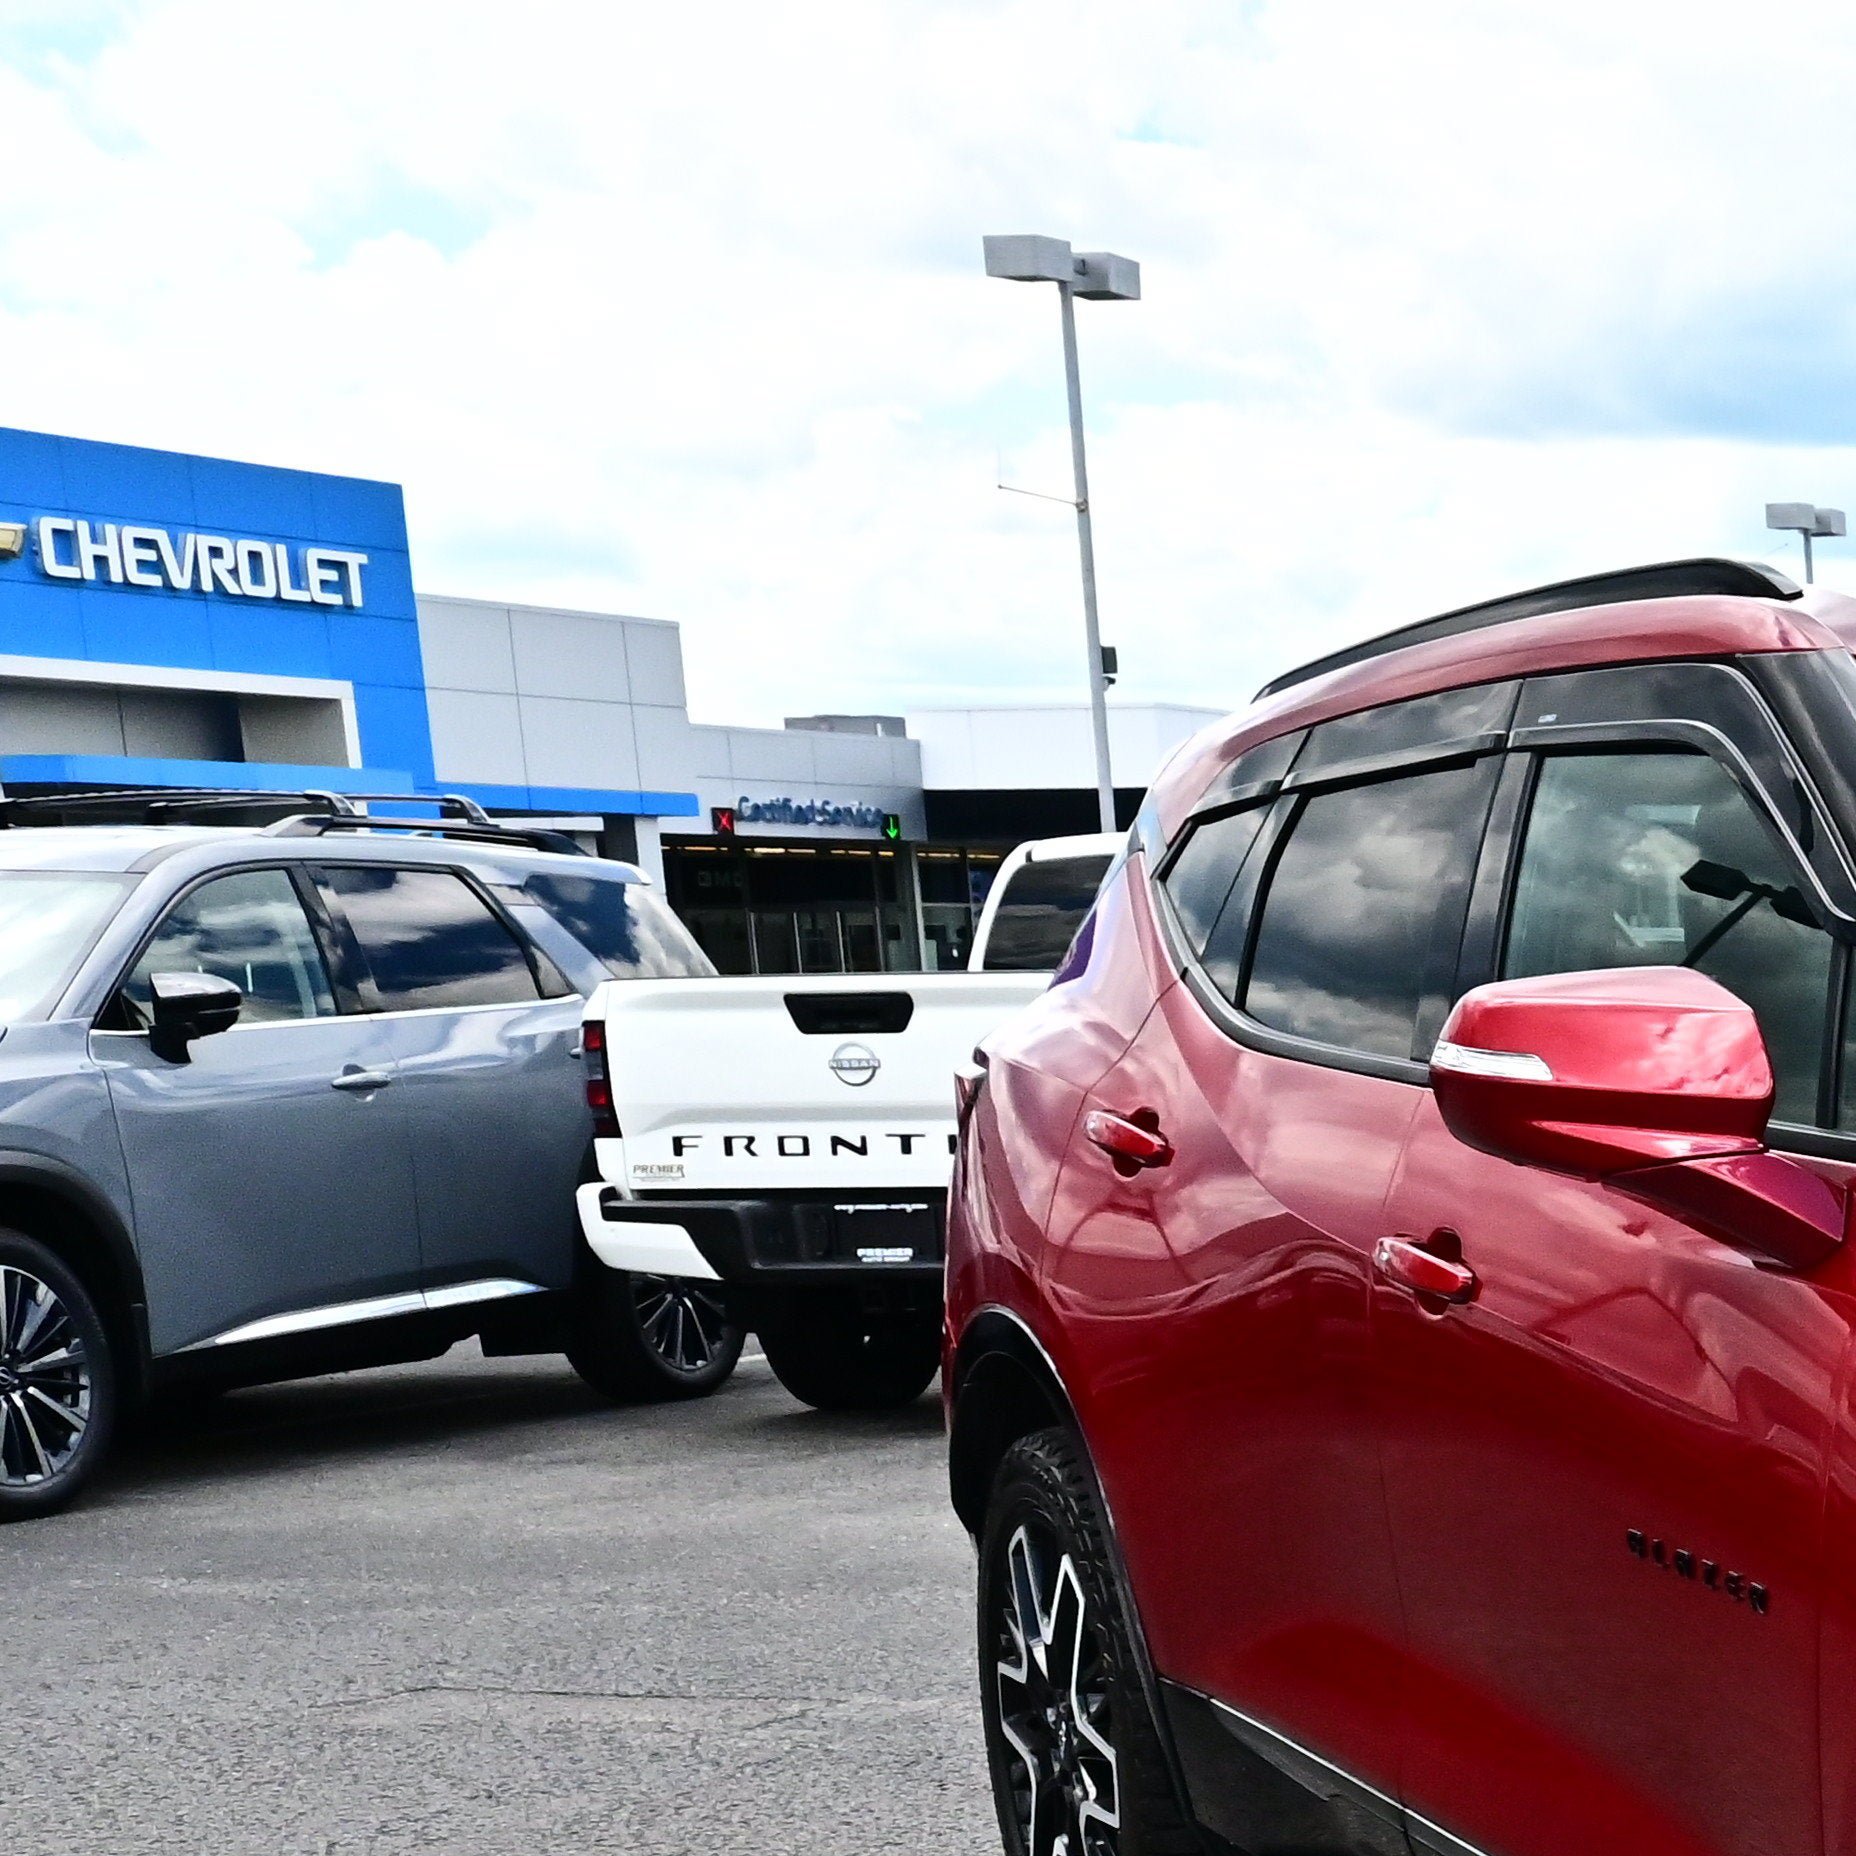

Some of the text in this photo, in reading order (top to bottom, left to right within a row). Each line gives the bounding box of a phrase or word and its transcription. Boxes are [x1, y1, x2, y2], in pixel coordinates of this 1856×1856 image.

[39, 516, 368, 608] CHEVROLET
[737, 796, 884, 829] Certified Service
[632, 1164, 685, 1178] PREMIER
